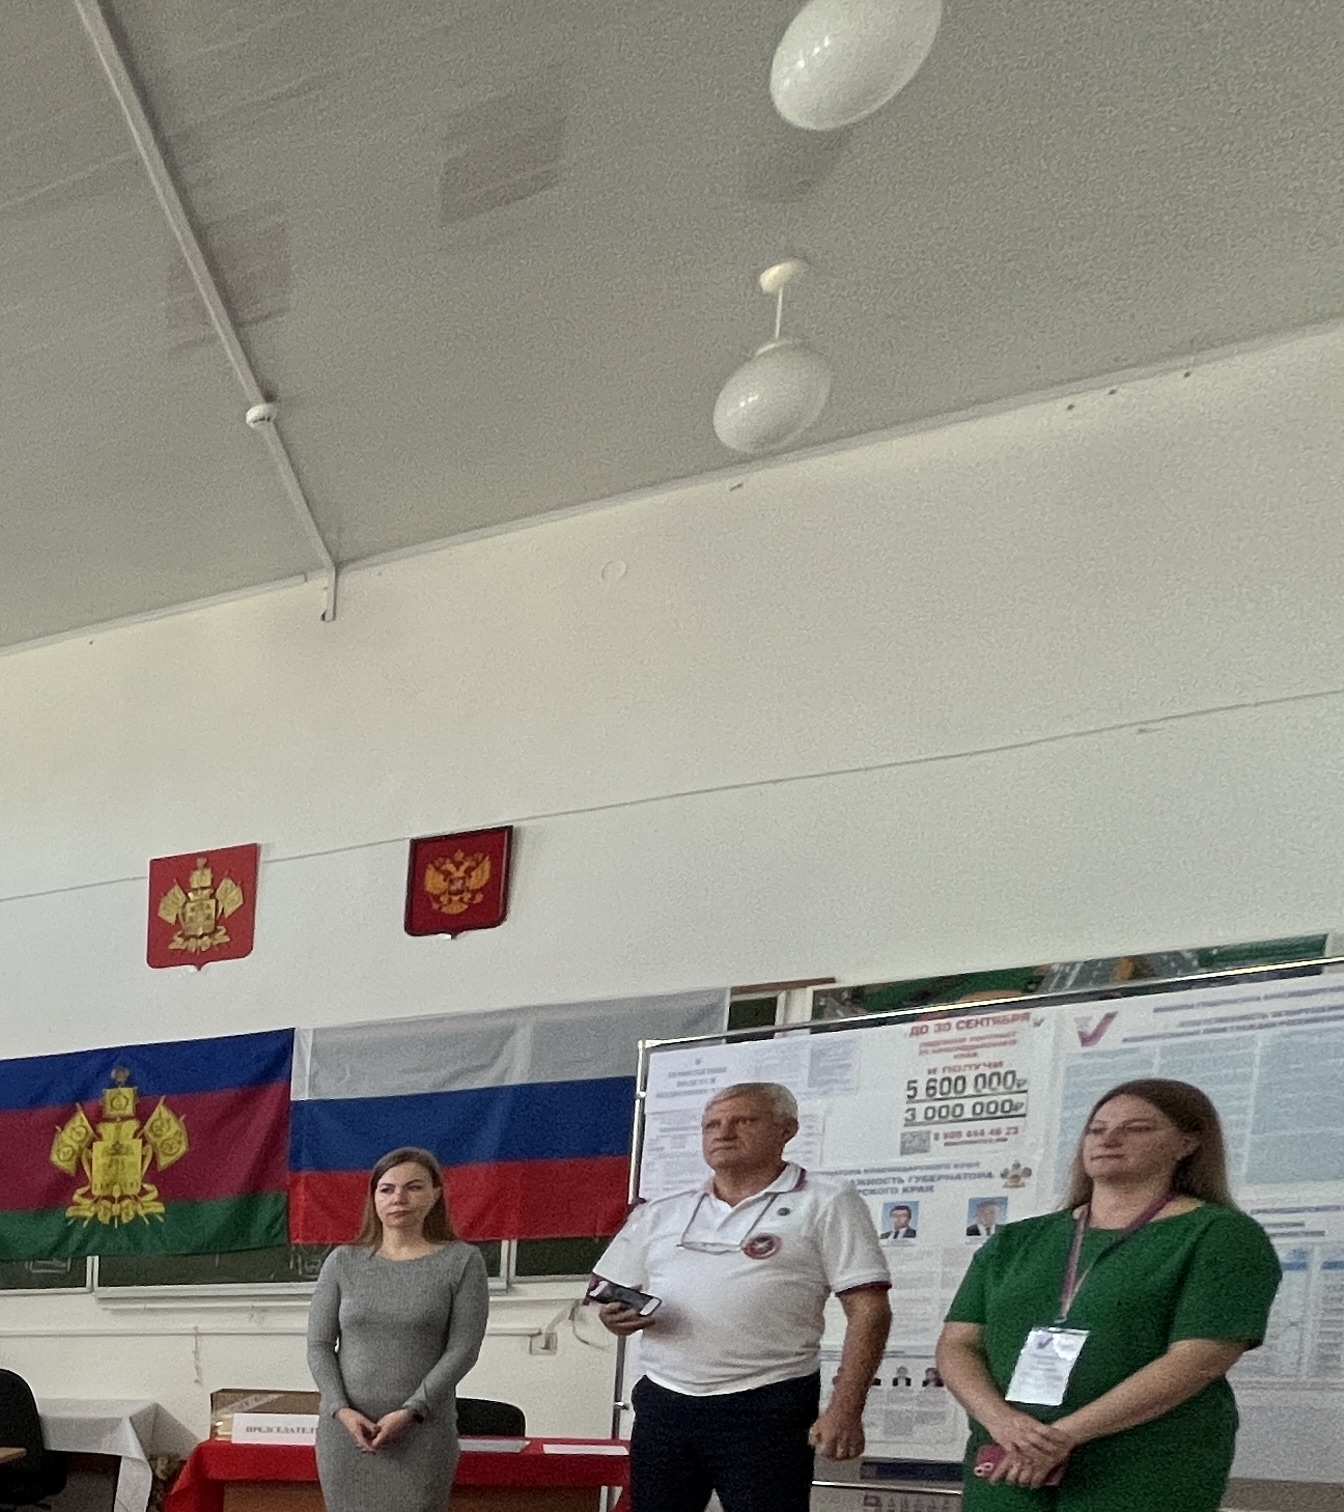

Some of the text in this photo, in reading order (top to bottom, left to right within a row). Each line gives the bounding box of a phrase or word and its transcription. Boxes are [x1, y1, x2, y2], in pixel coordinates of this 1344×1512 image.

[909, 1012, 1031, 1038] ДО 30 СЕНТЯБРЯ
[906, 1079, 918, 1099] 5
[925, 1075, 967, 1098] 600
[905, 1107, 916, 1122] 3
[923, 1103, 965, 1121] 000
[852, 1176, 905, 1186] ЖНОСТЬ
[245, 1425, 315, 1435] ПРЕДСЕДАТЕЛ
